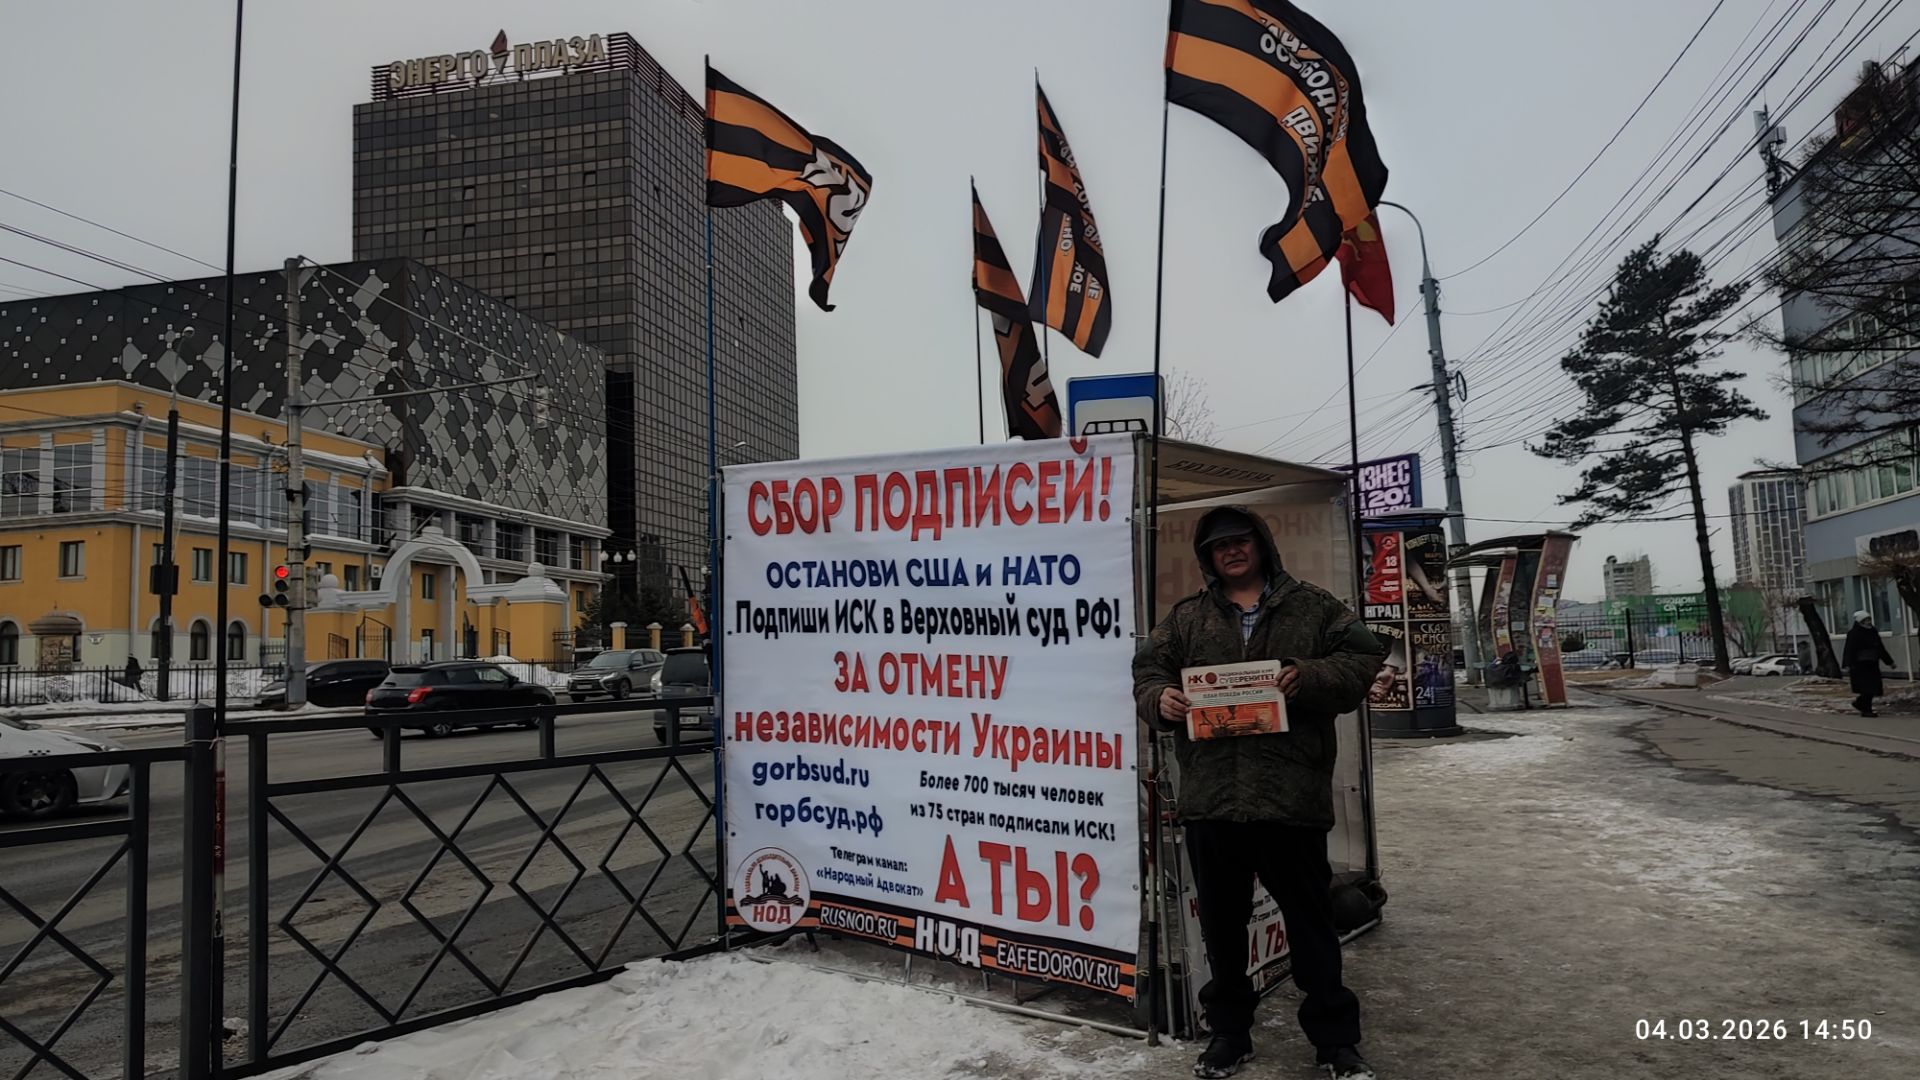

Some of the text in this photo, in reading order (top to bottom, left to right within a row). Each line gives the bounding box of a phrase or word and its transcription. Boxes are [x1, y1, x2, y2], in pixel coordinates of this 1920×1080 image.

[389, 33, 605, 89] ЭНЕРГО ПЛАЗА
[748, 477, 843, 536] СБОР
[854, 437, 1112, 541] ПОДПИСЕЙ!
[766, 554, 1081, 589] ОСТАНОВИ США и НАТО
[736, 593, 1120, 646] Подпиши ИСК в Верховный суд РФ!
[834, 651, 1009, 700] ЗА ОТМЕНУ
[735, 711, 1122, 771] независимости Украины
[752, 755, 869, 788] gorbsud.ru
[919, 771, 1104, 807] Более 700 тысяч человек
[755, 797, 883, 837] горбсуд.рф
[910, 802, 1115, 842] из 75 стран подписали ИСК!
[830, 846, 908, 873] Телеграм канал:
[816, 867, 874, 888] «Народный
[876, 880, 924, 897] Адвокат»
[935, 834, 1100, 932] А ТЫ?
[753, 905, 791, 925] НОД
[820, 906, 898, 939] RUSNOD.RU
[914, 915, 981, 969] НОД
[996, 940, 1121, 990] EAFEDOROV.RU
